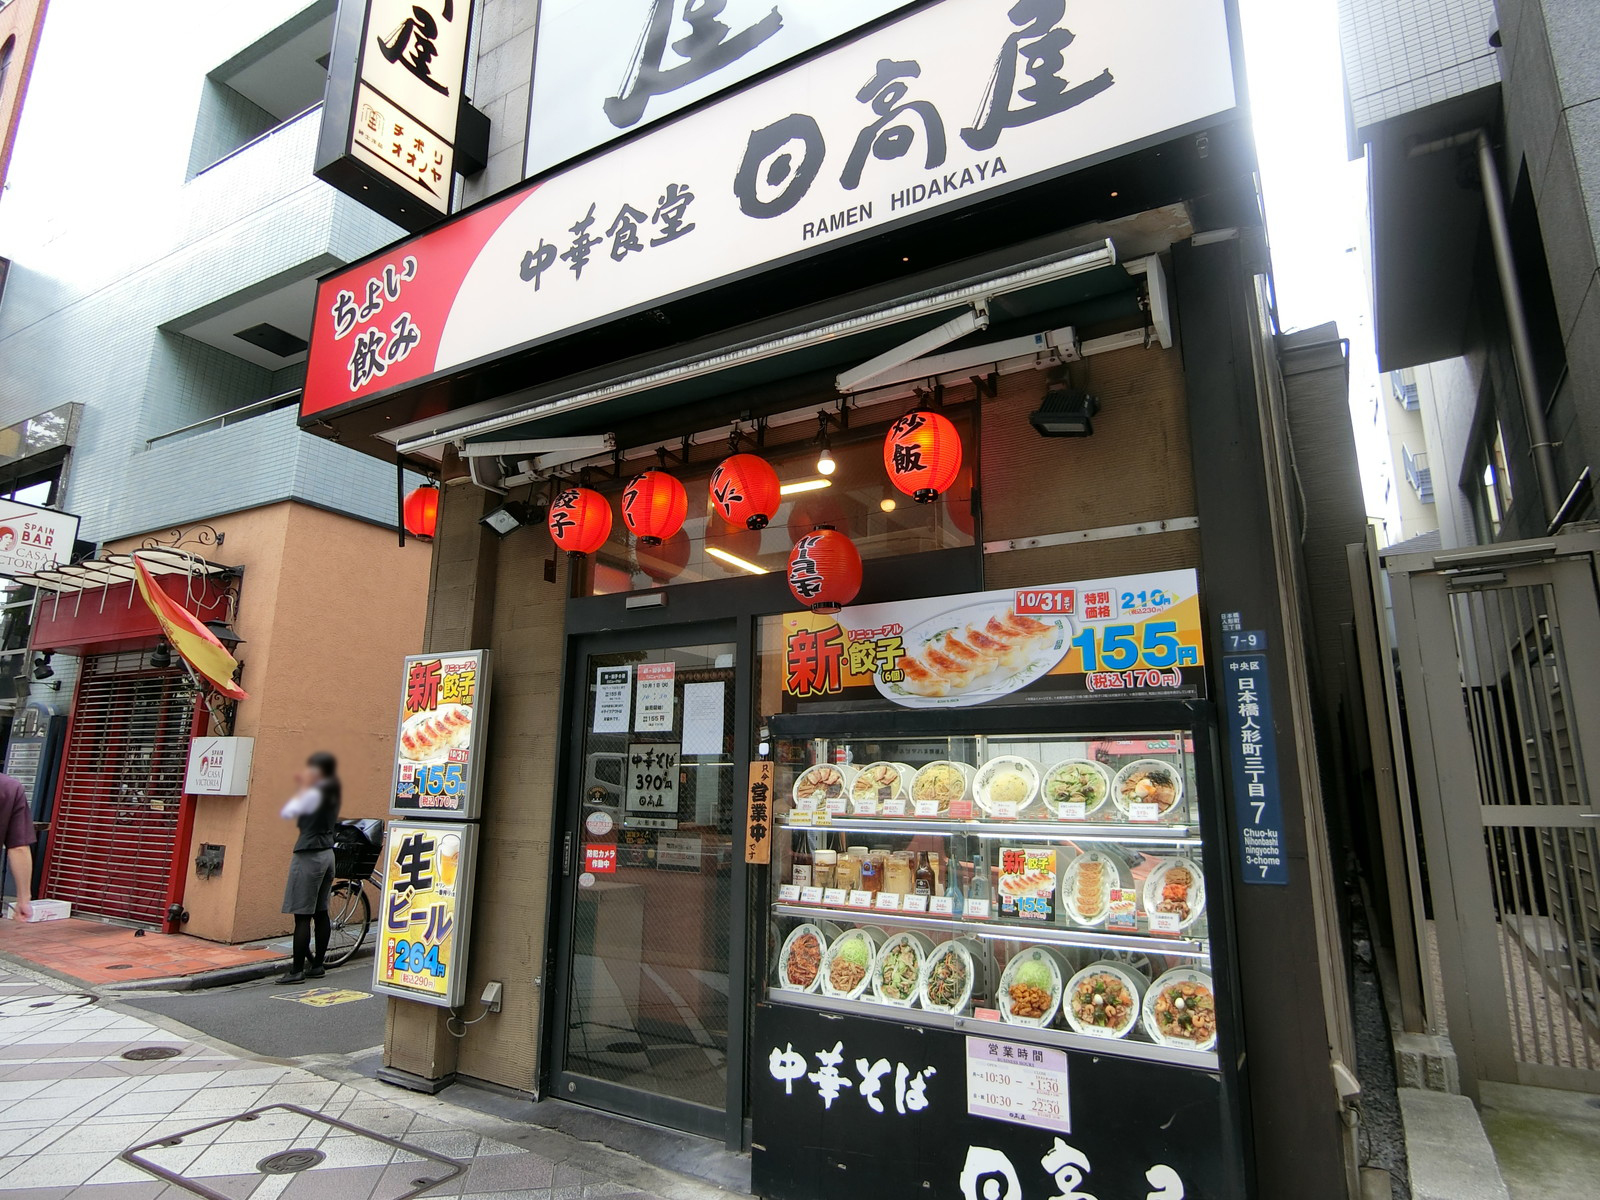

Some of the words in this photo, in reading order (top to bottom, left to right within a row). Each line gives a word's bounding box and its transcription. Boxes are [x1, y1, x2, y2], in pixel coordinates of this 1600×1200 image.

[377, 0, 454, 97] 屋
[519, 183, 695, 292] 中華食堂
[733, 0, 1116, 219] 日高屋
[803, 201, 874, 241] RAMEN
[891, 157, 1008, 212] HIDAKAYA
[349, 313, 420, 390] 飲み
[891, 413, 928, 474] 炒飯
[551, 489, 581, 539] 餃子
[21, 531, 54, 547] BAR
[24, 522, 55, 536] SPAIN
[16, 548, 48, 562] CASA
[1018, 592, 1073, 612] 10/31まで
[1084, 591, 1110, 605] 特別
[1121, 588, 1171, 609] 210円
[1085, 606, 1111, 619] 価格
[847, 623, 904, 641] リニューアル
[1230, 634, 1257, 648] 7-9
[1072, 621, 1198, 672] 155円
[787, 624, 906, 696] 新・餃子
[1229, 661, 1260, 671] 中央区
[406, 659, 476, 713] 新・餃子
[881, 669, 906, 684] (6個)
[1085, 667, 1182, 692] (税込170円)
[1238, 677, 1265, 797] 日本橋人形町三丁目
[210, 756, 223, 765] BAR
[632, 747, 677, 771] 中華そば
[416, 764, 467, 796] 155円
[635, 773, 673, 791] 390円
[761, 763, 770, 781] 只今
[639, 794, 664, 808] 日高屋
[750, 782, 769, 843] 営業中
[1250, 801, 1265, 824] 7
[1243, 828, 1278, 838] Chuo-ku
[1244, 837, 1279, 846] Nihonbashi
[586, 849, 616, 859] 防犯カメラ
[749, 843, 757, 860] です
[1245, 846, 1280, 856] ningyocho
[1246, 855, 1280, 865] 3-chome
[394, 831, 436, 892] 生
[1259, 865, 1268, 878] 7
[388, 887, 454, 943] ビール
[394, 939, 446, 977] 264円
[401, 972, 436, 988] (税込290円)
[988, 1042, 1044, 1063] 営業時間
[769, 1040, 937, 1115] 中華そば
[985, 1071, 1011, 1086] 10:30
[986, 1093, 1012, 1107] 10:30
[1031, 1100, 1060, 1114] 22:30
[959, 1137, 1185, 1200] 日高
